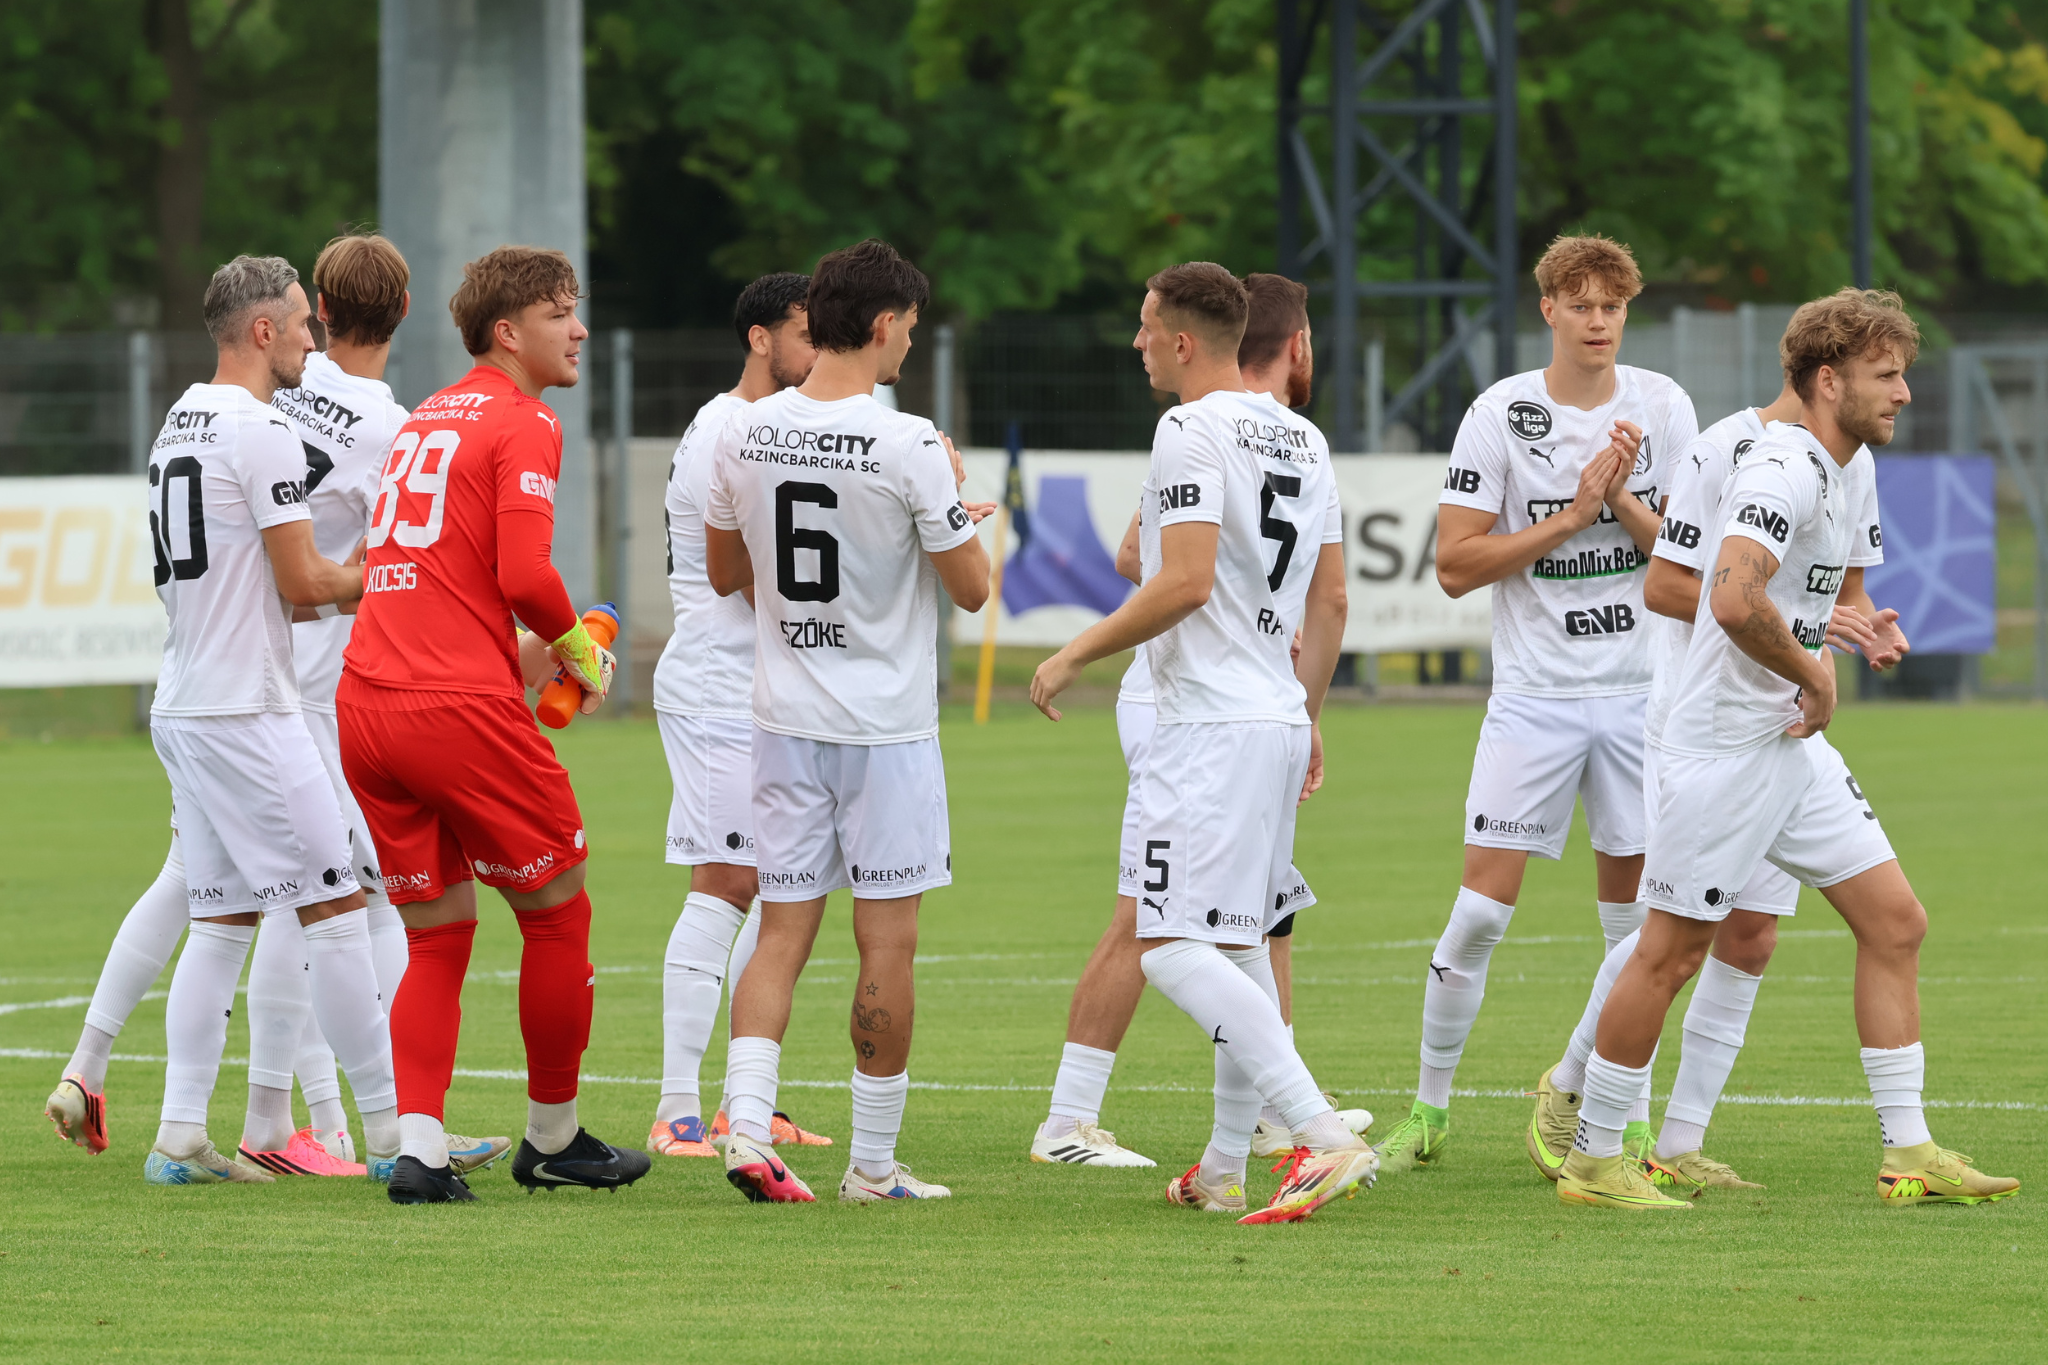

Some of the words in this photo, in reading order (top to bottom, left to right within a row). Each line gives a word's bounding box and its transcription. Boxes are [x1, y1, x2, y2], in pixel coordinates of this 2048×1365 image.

[465, 411, 483, 421] SC
[1522, 411, 1545, 422] fizz
[1523, 422, 1546, 434] liga
[200, 432, 217, 443] SC
[336, 431, 355, 448] SC
[746, 425, 877, 456] KOLORCITY
[739, 448, 855, 471] KAZINCBARCIKA
[860, 460, 880, 473] SC
[271, 480, 307, 506] GN
[366, 430, 461, 549] 89
[520, 471, 556, 504] GN
[1444, 467, 1481, 494] NB
[1260, 471, 1301, 593] 5
[1737, 504, 1789, 544] GNB
[776, 480, 839, 604] 6
[365, 562, 417, 593] KOCSIS
[1565, 603, 1635, 636] GNB
[862, 862, 927, 882] GREENPLAN
[1143, 840, 1171, 892] 5
